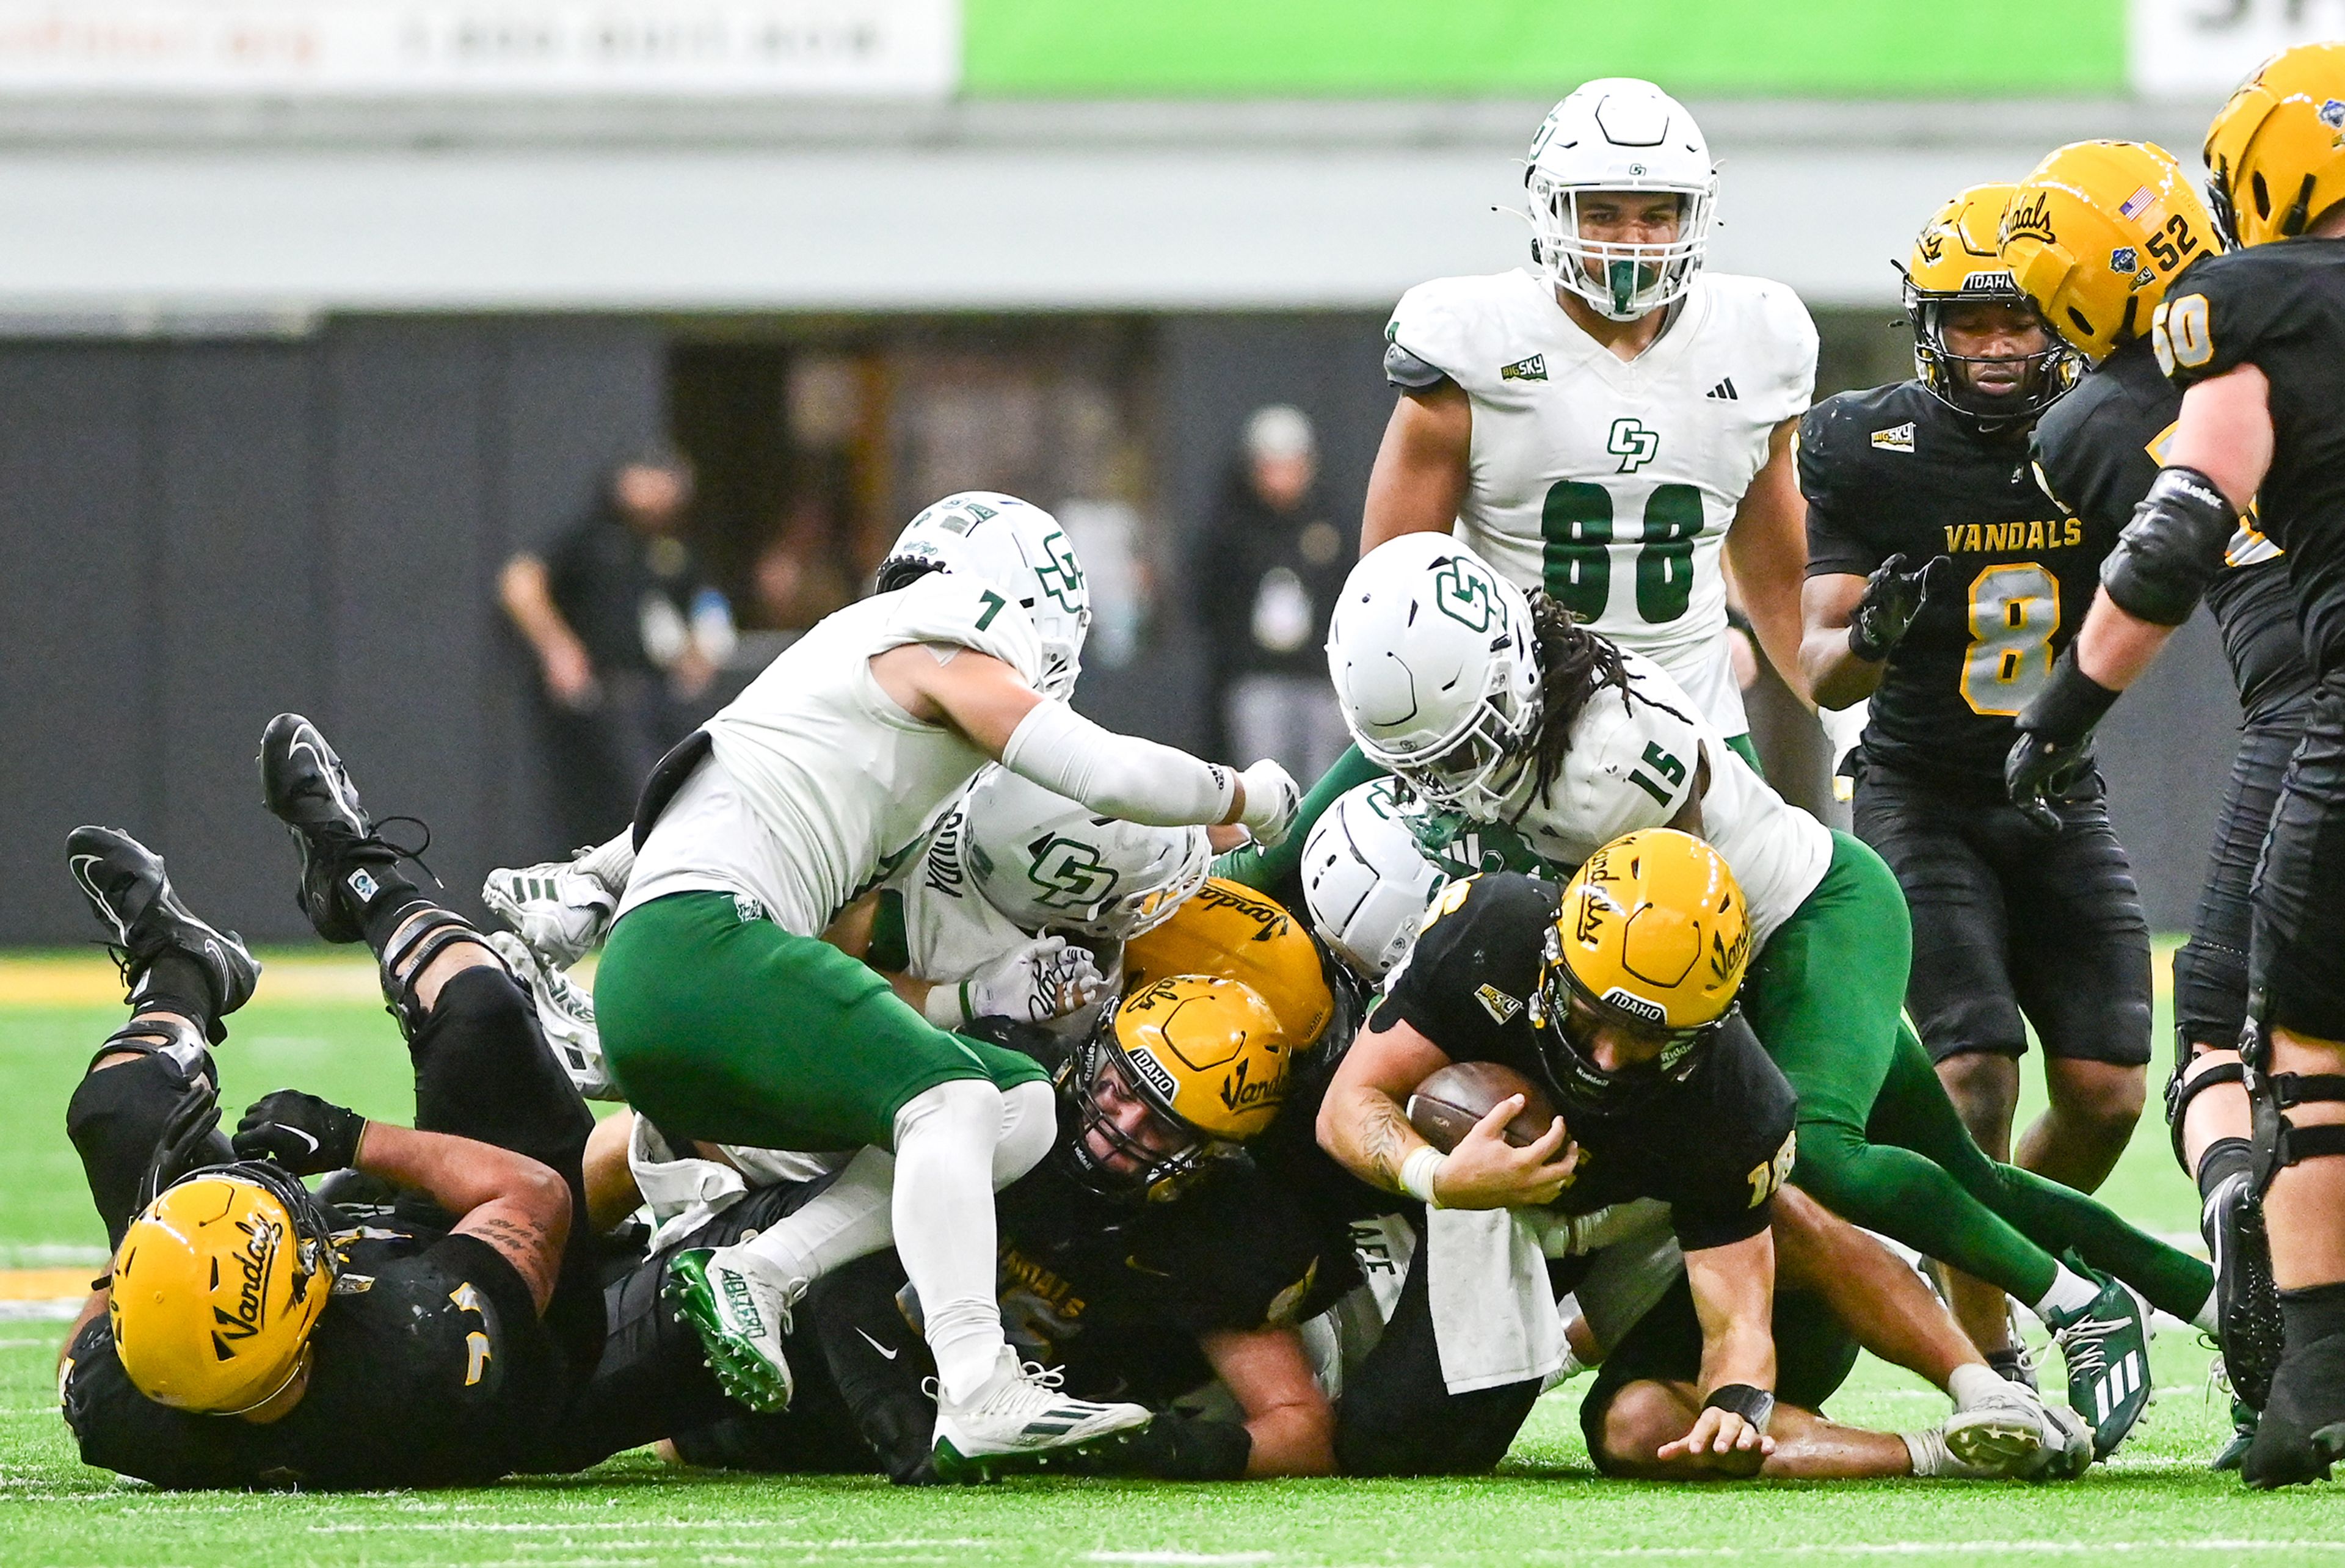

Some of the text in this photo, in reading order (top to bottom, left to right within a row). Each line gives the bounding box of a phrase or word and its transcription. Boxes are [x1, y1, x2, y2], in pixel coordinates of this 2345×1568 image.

[2145, 214, 2198, 272] 52
[1607, 418, 1659, 474] CP
[1541, 479, 1704, 625] 88
[1943, 517, 2082, 553] VANDALS
[975, 589, 1006, 632] 7
[1959, 562, 2061, 716] 8
[1627, 740, 1687, 808] 15
[1028, 837, 1119, 909] CP
[1196, 885, 1288, 942] Vanda
[1611, 992, 1662, 1022] IDAHO
[1133, 1050, 1174, 1094] IDAHO
[212, 1213, 283, 1340] Vandals
